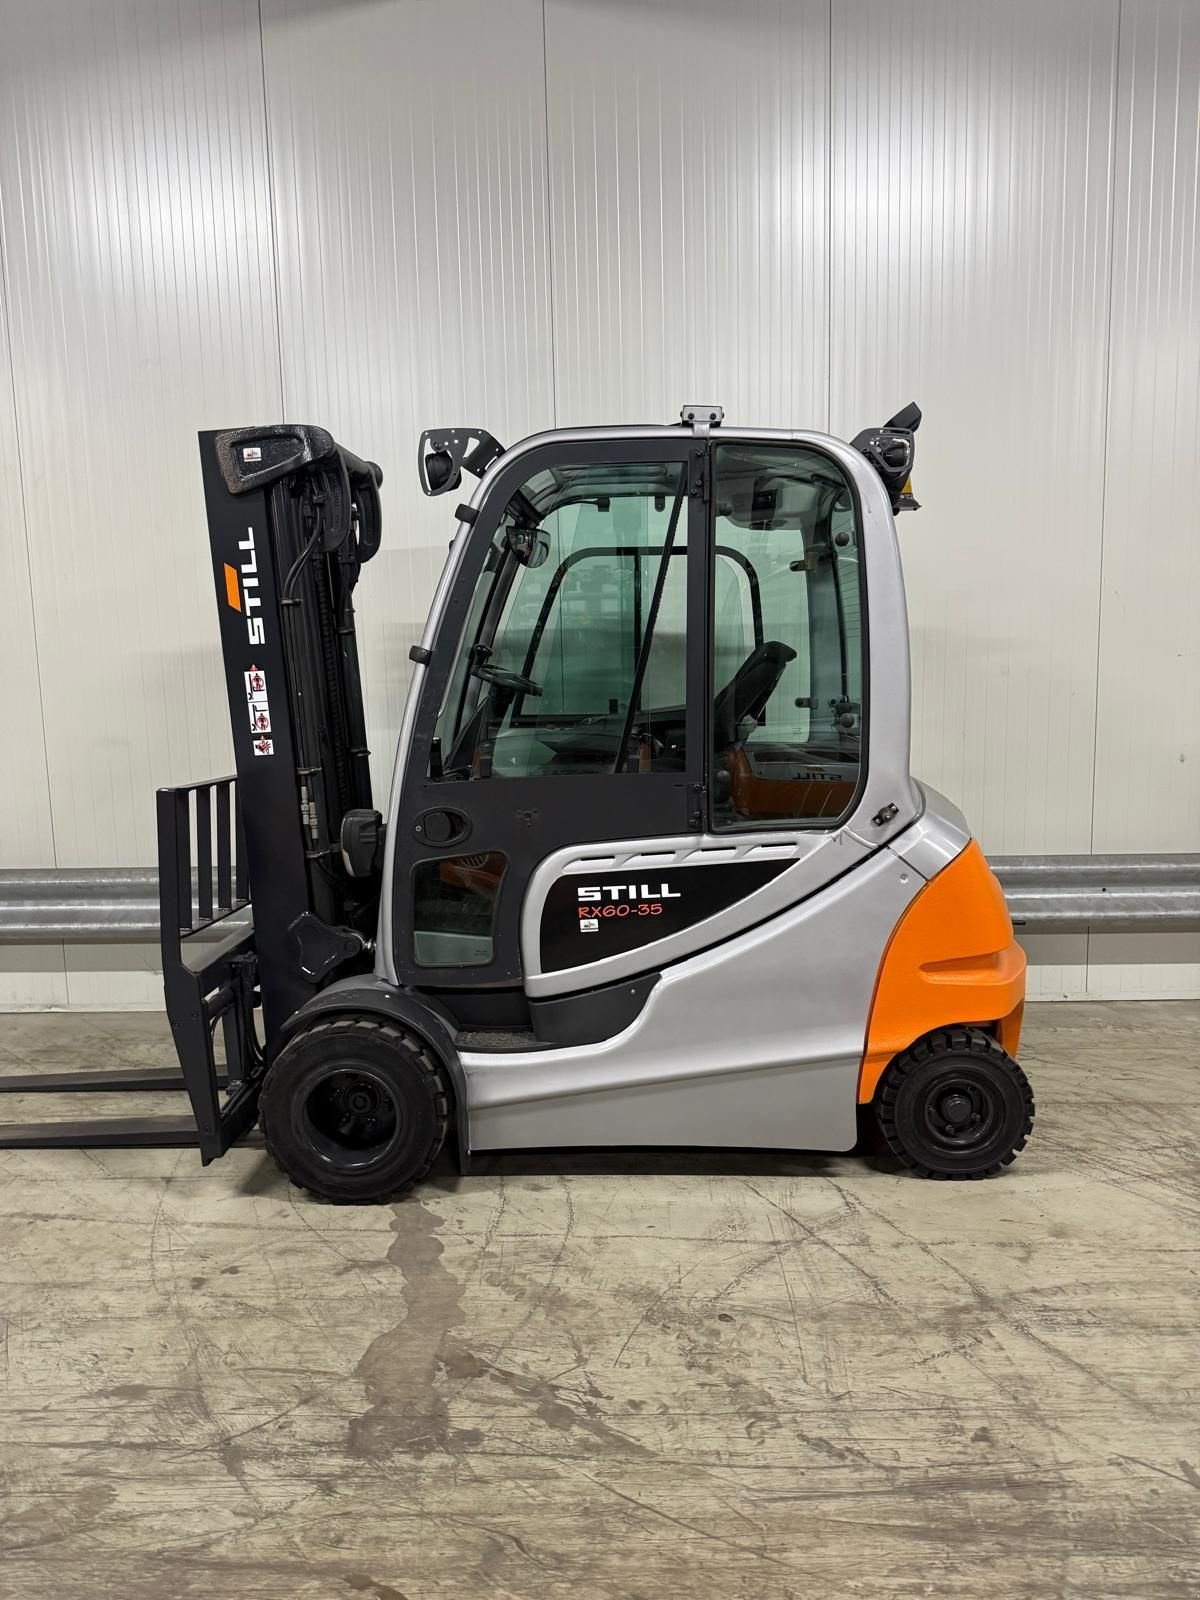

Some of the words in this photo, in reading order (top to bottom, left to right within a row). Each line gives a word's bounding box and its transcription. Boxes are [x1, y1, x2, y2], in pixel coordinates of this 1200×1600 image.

[238, 526, 266, 645] STILL
[577, 883, 681, 902] STILL
[577, 903, 663, 918] RX60-35
